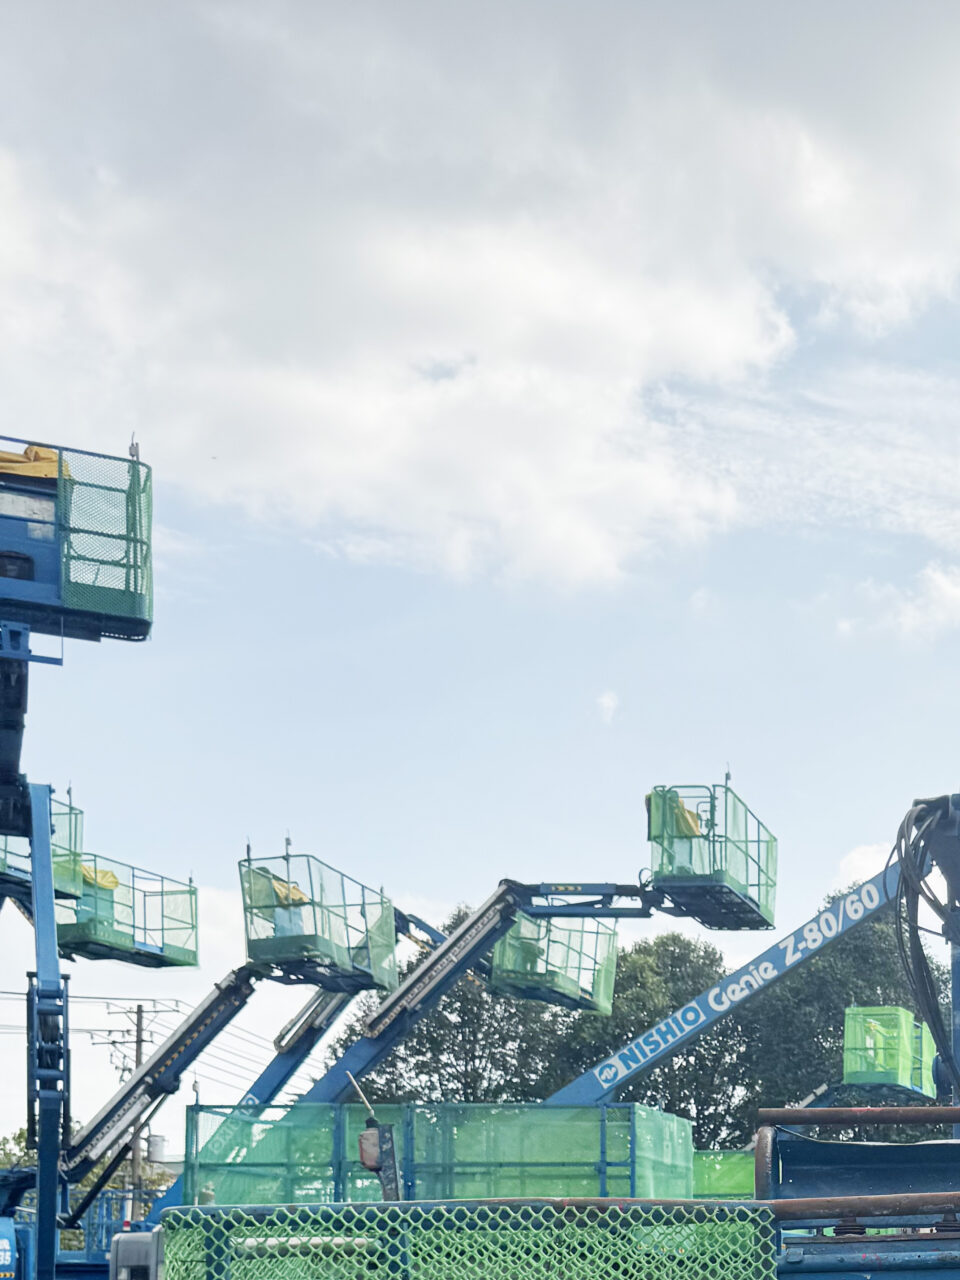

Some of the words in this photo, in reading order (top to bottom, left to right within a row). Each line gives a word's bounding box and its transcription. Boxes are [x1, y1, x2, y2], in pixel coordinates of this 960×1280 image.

[617, 1005, 702, 1072] NISHIO
[707, 961, 778, 1012] Genie
[779, 883, 880, 968] Z-80/60
